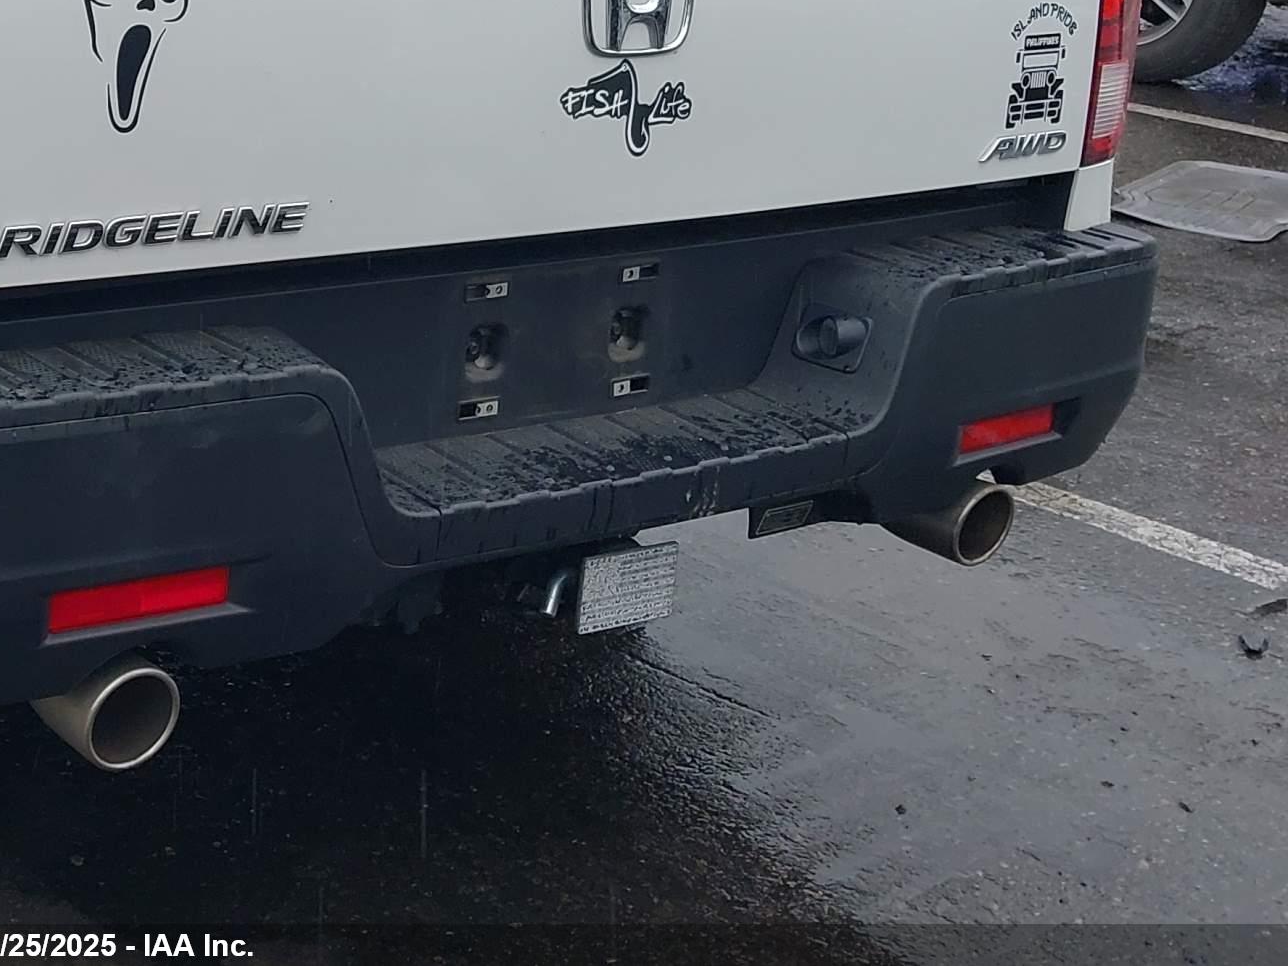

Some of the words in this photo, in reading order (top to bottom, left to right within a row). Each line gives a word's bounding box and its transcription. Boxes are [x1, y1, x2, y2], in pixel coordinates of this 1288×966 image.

[1010, 2, 1049, 41] ISLAND
[1050, 2, 1078, 36] PRIDE
[561, 89, 628, 119] FISH
[648, 83, 691, 123] Life
[978, 131, 1067, 163] AWD
